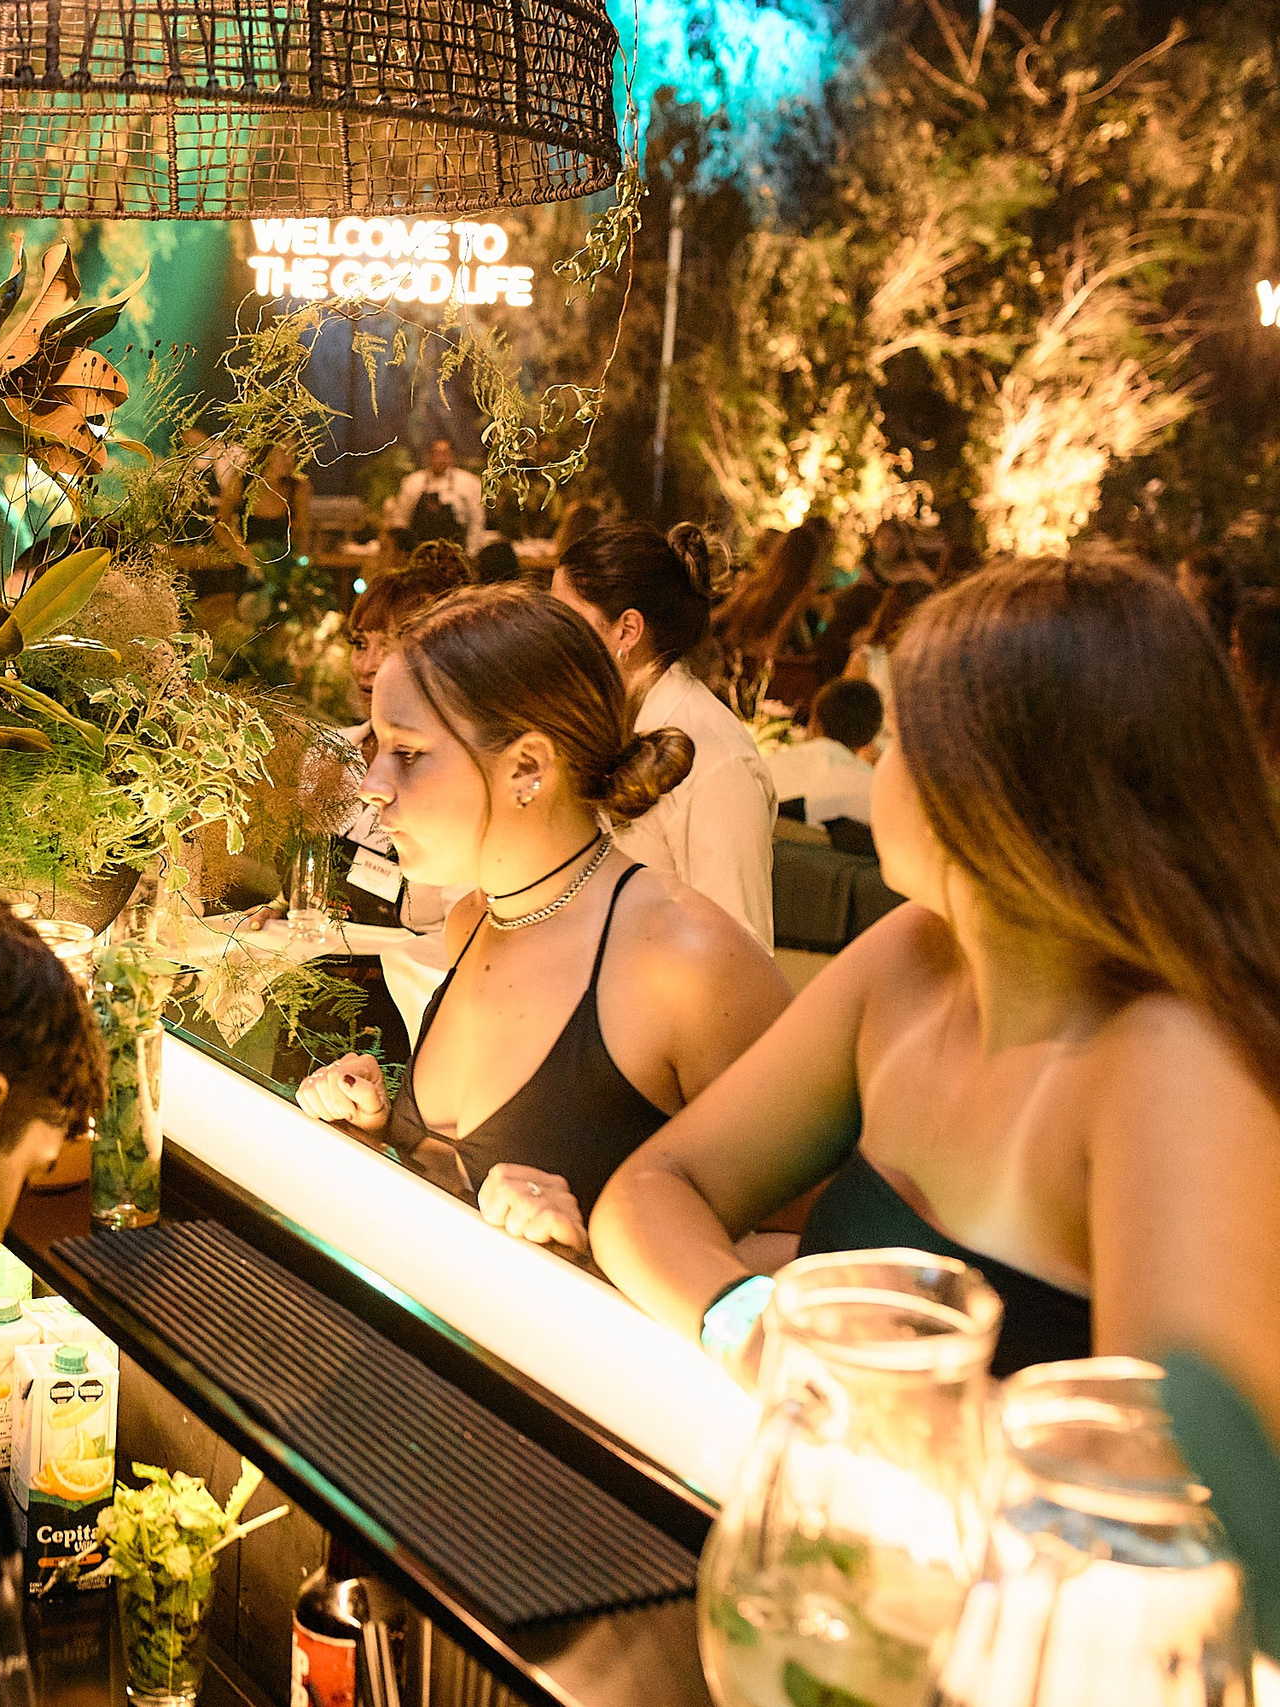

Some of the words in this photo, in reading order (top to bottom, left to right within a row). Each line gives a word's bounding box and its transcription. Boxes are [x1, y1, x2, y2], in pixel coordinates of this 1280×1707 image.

[252, 217, 451, 261] WELCOME
[453, 221, 508, 263] TO
[248, 256, 330, 299] THE
[330, 259, 454, 304] GOOD
[455, 264, 535, 307] LIFE
